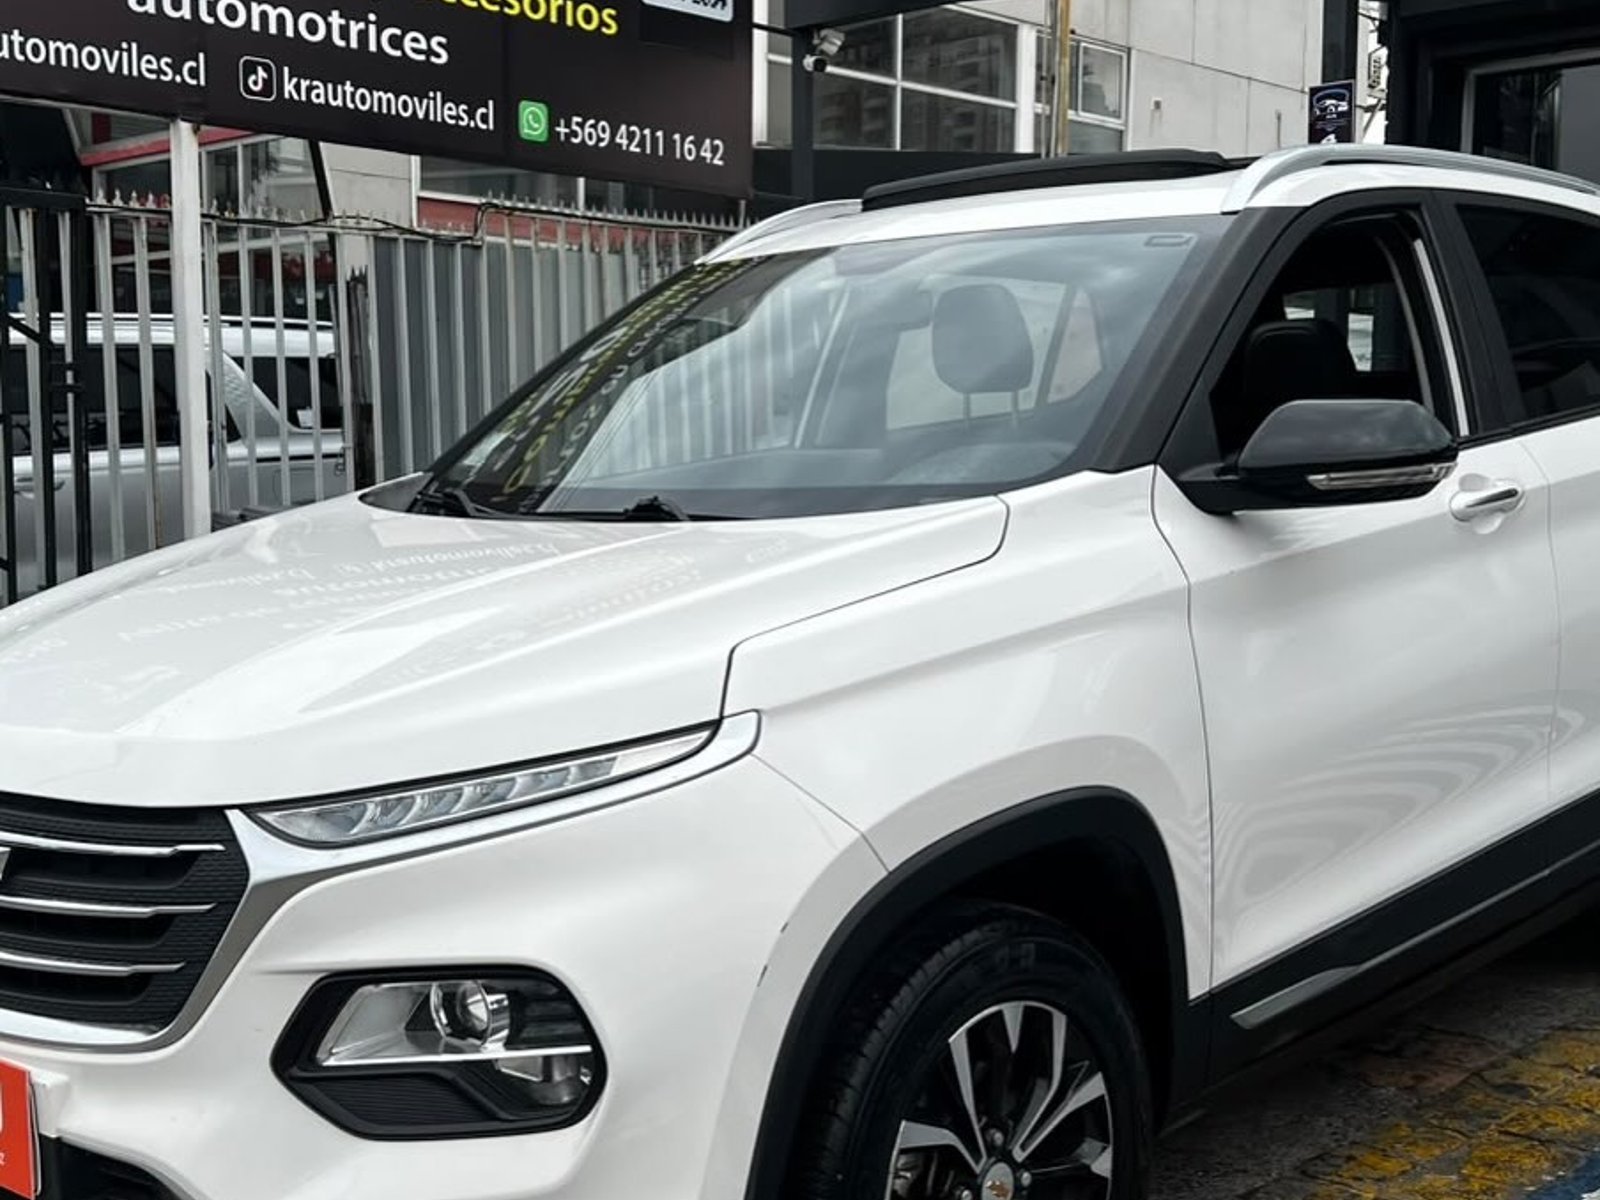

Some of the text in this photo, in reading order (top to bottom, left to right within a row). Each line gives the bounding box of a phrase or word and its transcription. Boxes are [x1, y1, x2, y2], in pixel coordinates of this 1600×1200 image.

[283, 65, 495, 131] krautomoviles.cl
[554, 116, 611, 147] +569
[615, 124, 665, 156] 4211
